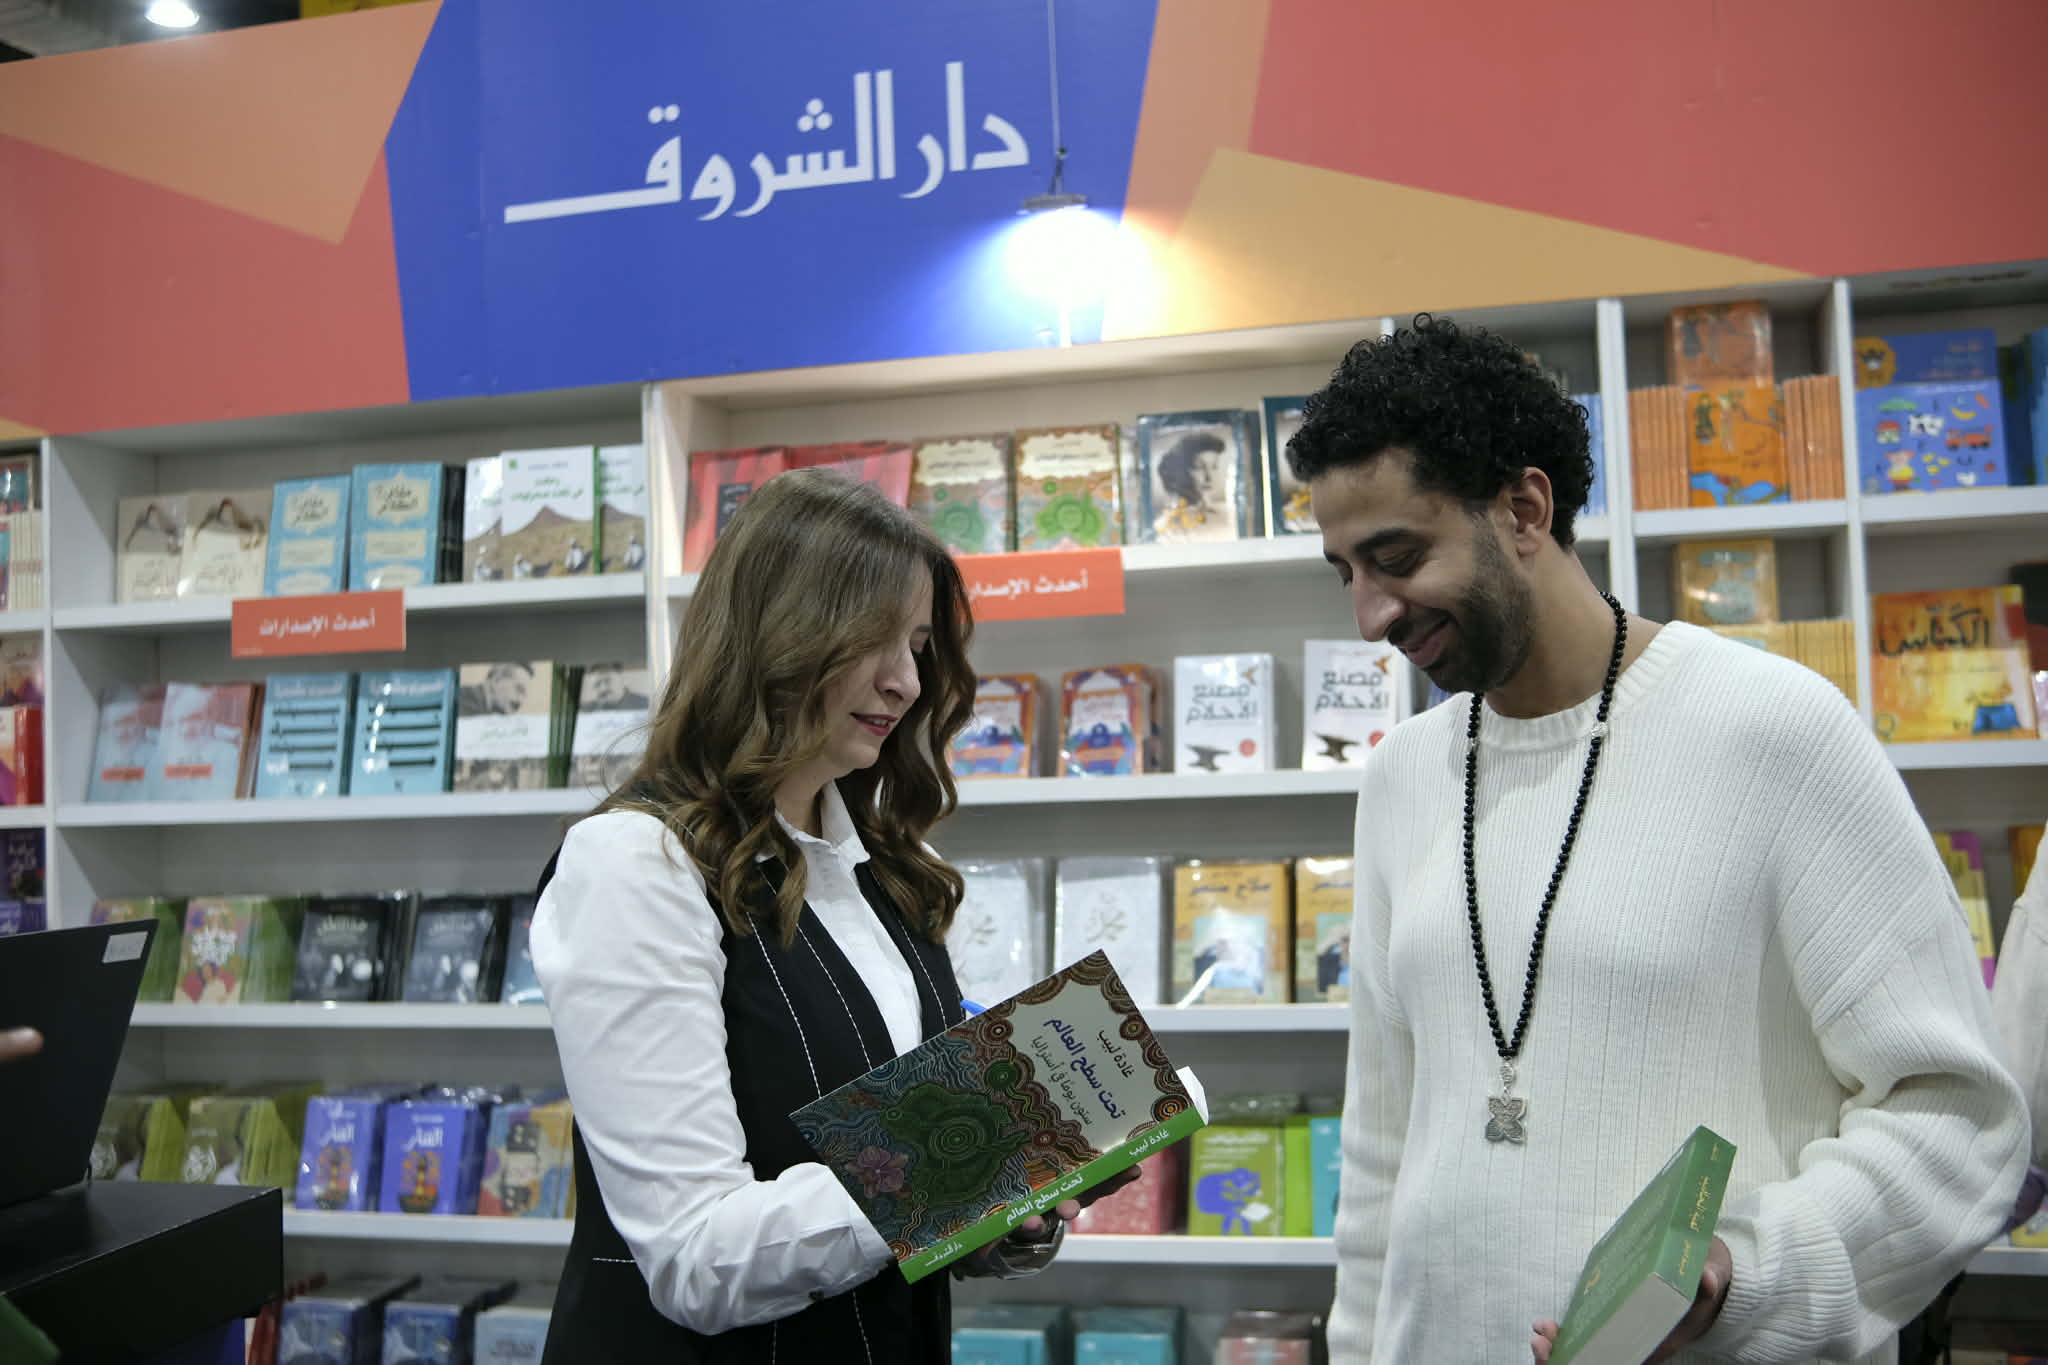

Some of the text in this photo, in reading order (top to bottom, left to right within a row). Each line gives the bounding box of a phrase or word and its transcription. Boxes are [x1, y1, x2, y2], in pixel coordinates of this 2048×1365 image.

[504, 61, 1030, 224] دار الشروق
[968, 568, 1089, 601] أحدث الإصدار
[259, 607, 376, 640] أحدث الإصدارات
[1191, 682, 1251, 704] مصنع
[1321, 670, 1383, 692] مصنع
[1042, 1019, 1127, 1119] تحت سطح العالم
[1096, 1030, 1135, 1078] غادة لبيب
[1048, 1070, 1068, 1083] في
[1070, 1101, 1095, 1126] ستون
[1129, 1129, 1170, 1158] غادة لبيب
[1005, 1173, 1084, 1226] تحت سطح العالم
